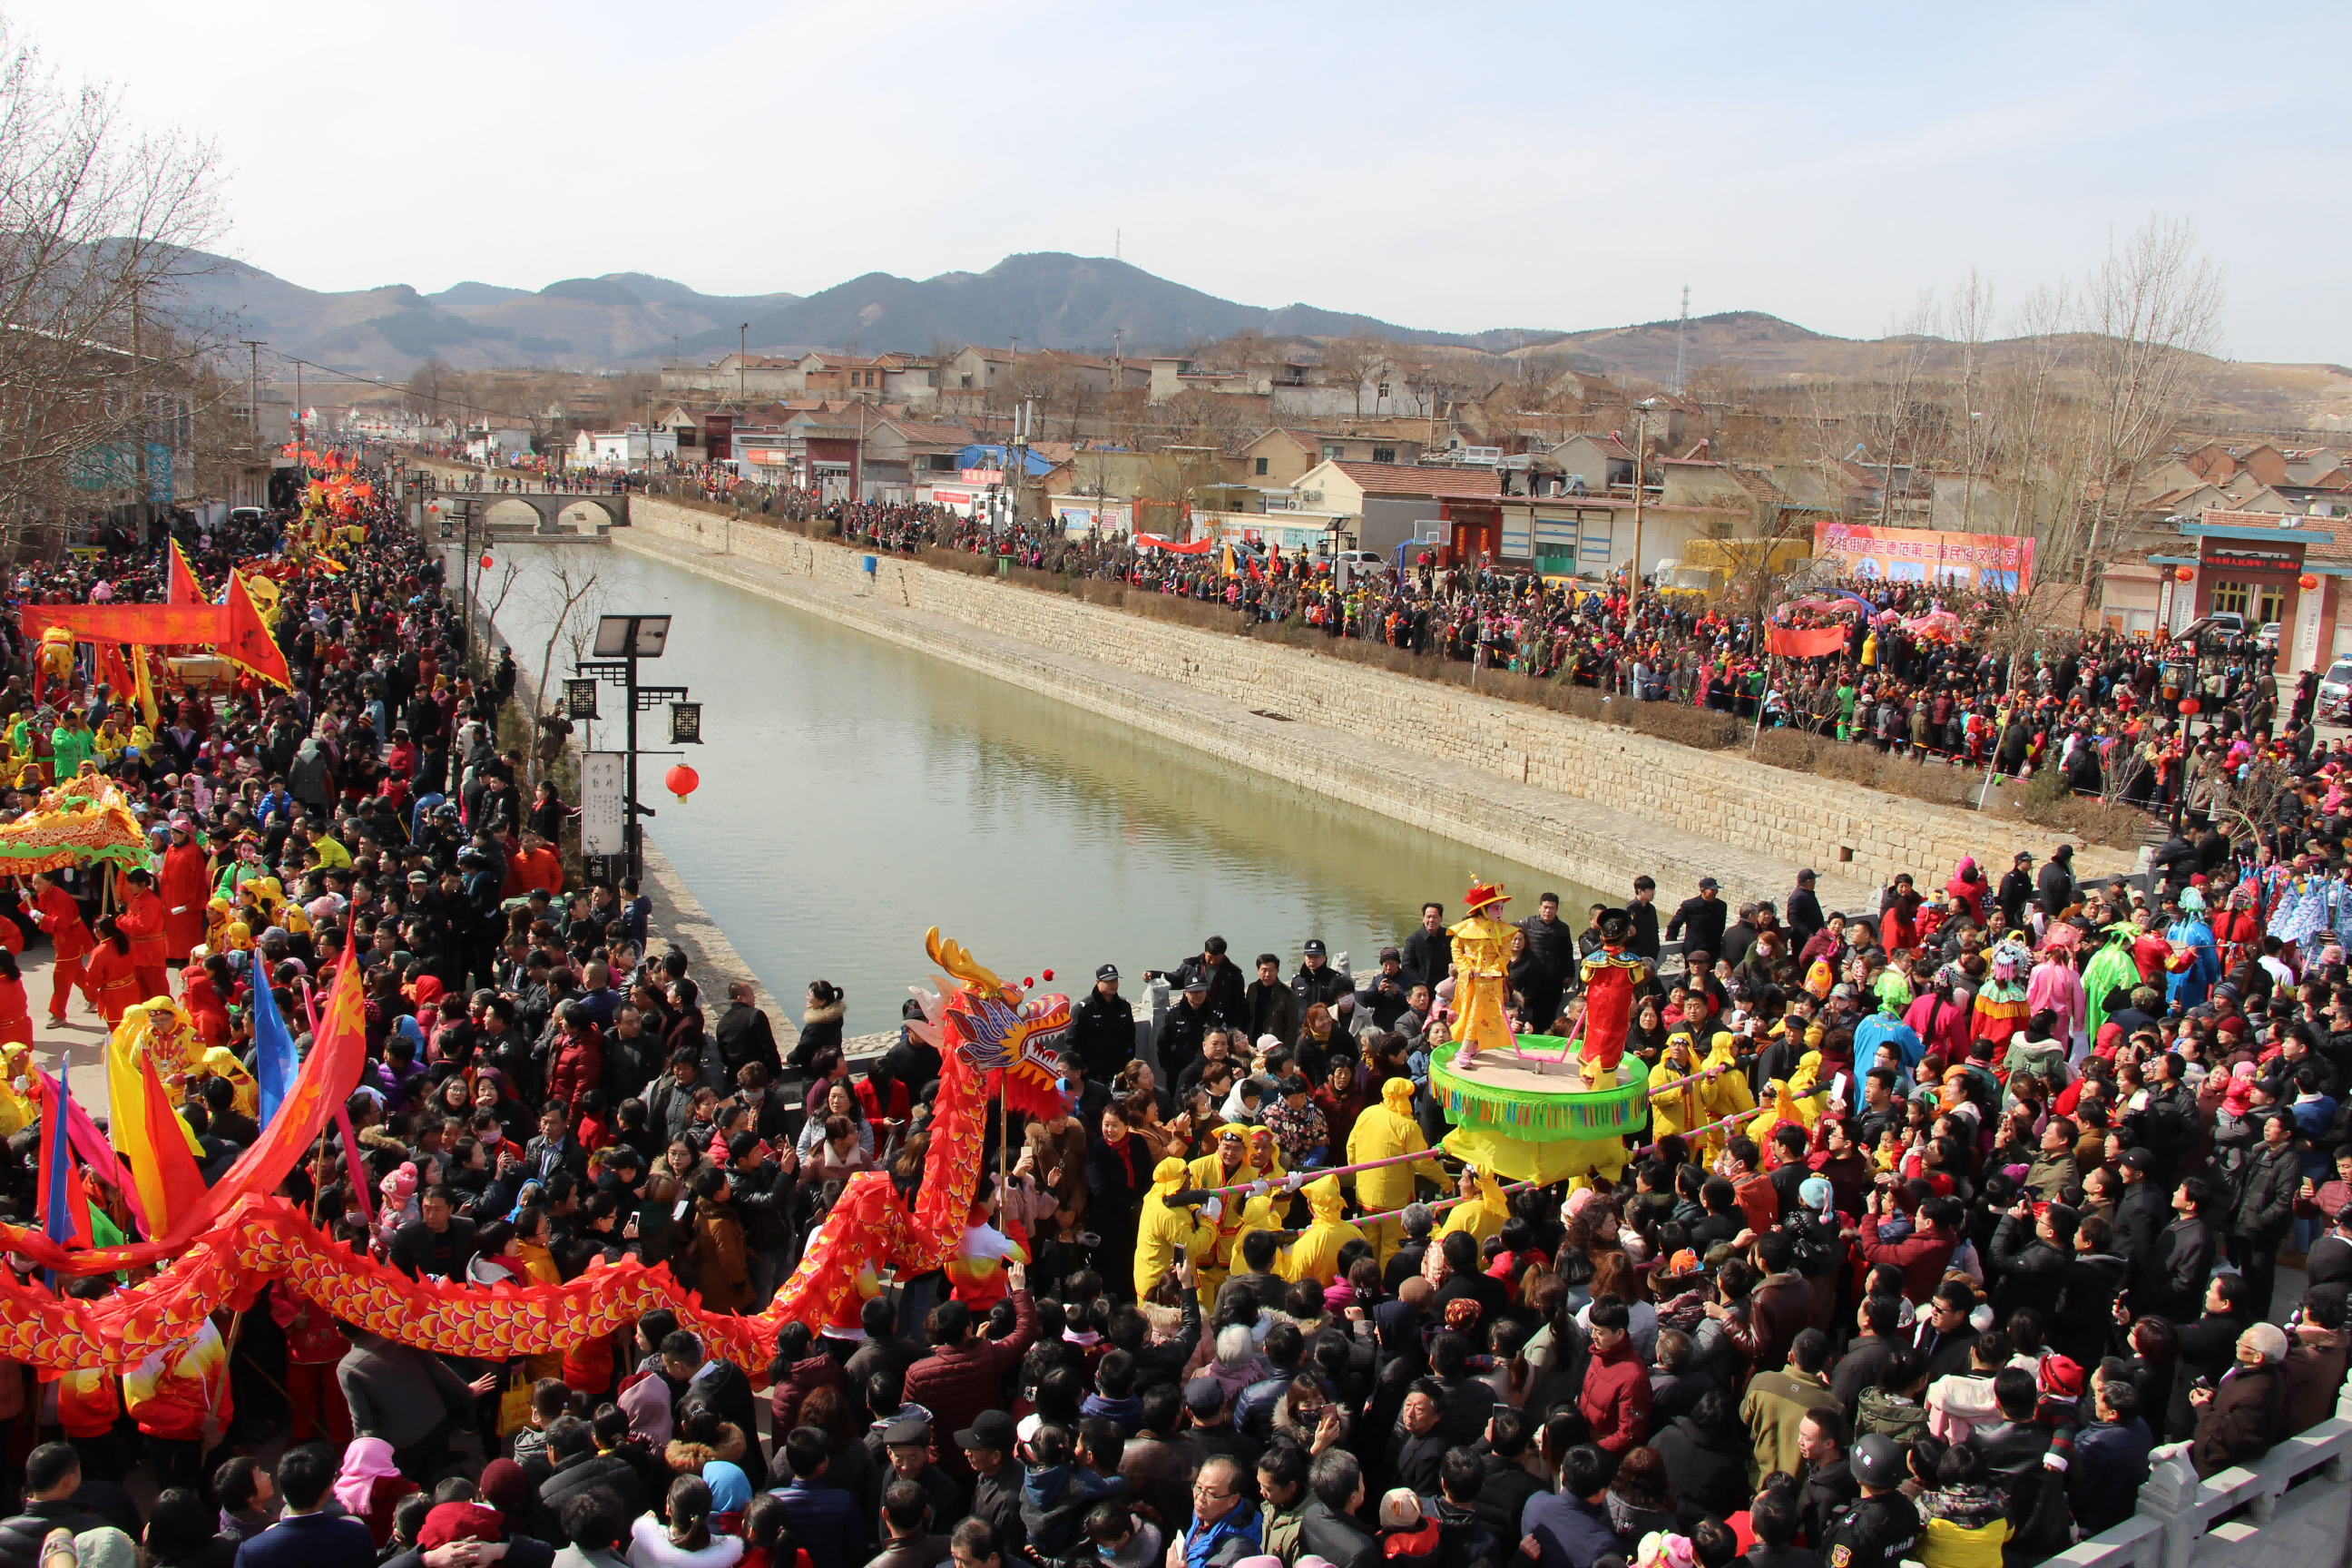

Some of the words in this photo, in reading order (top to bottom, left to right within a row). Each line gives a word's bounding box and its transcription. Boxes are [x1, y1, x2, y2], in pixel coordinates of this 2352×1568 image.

[1826, 535, 2018, 565] 文祖街道三德范第二届民俗文化节
